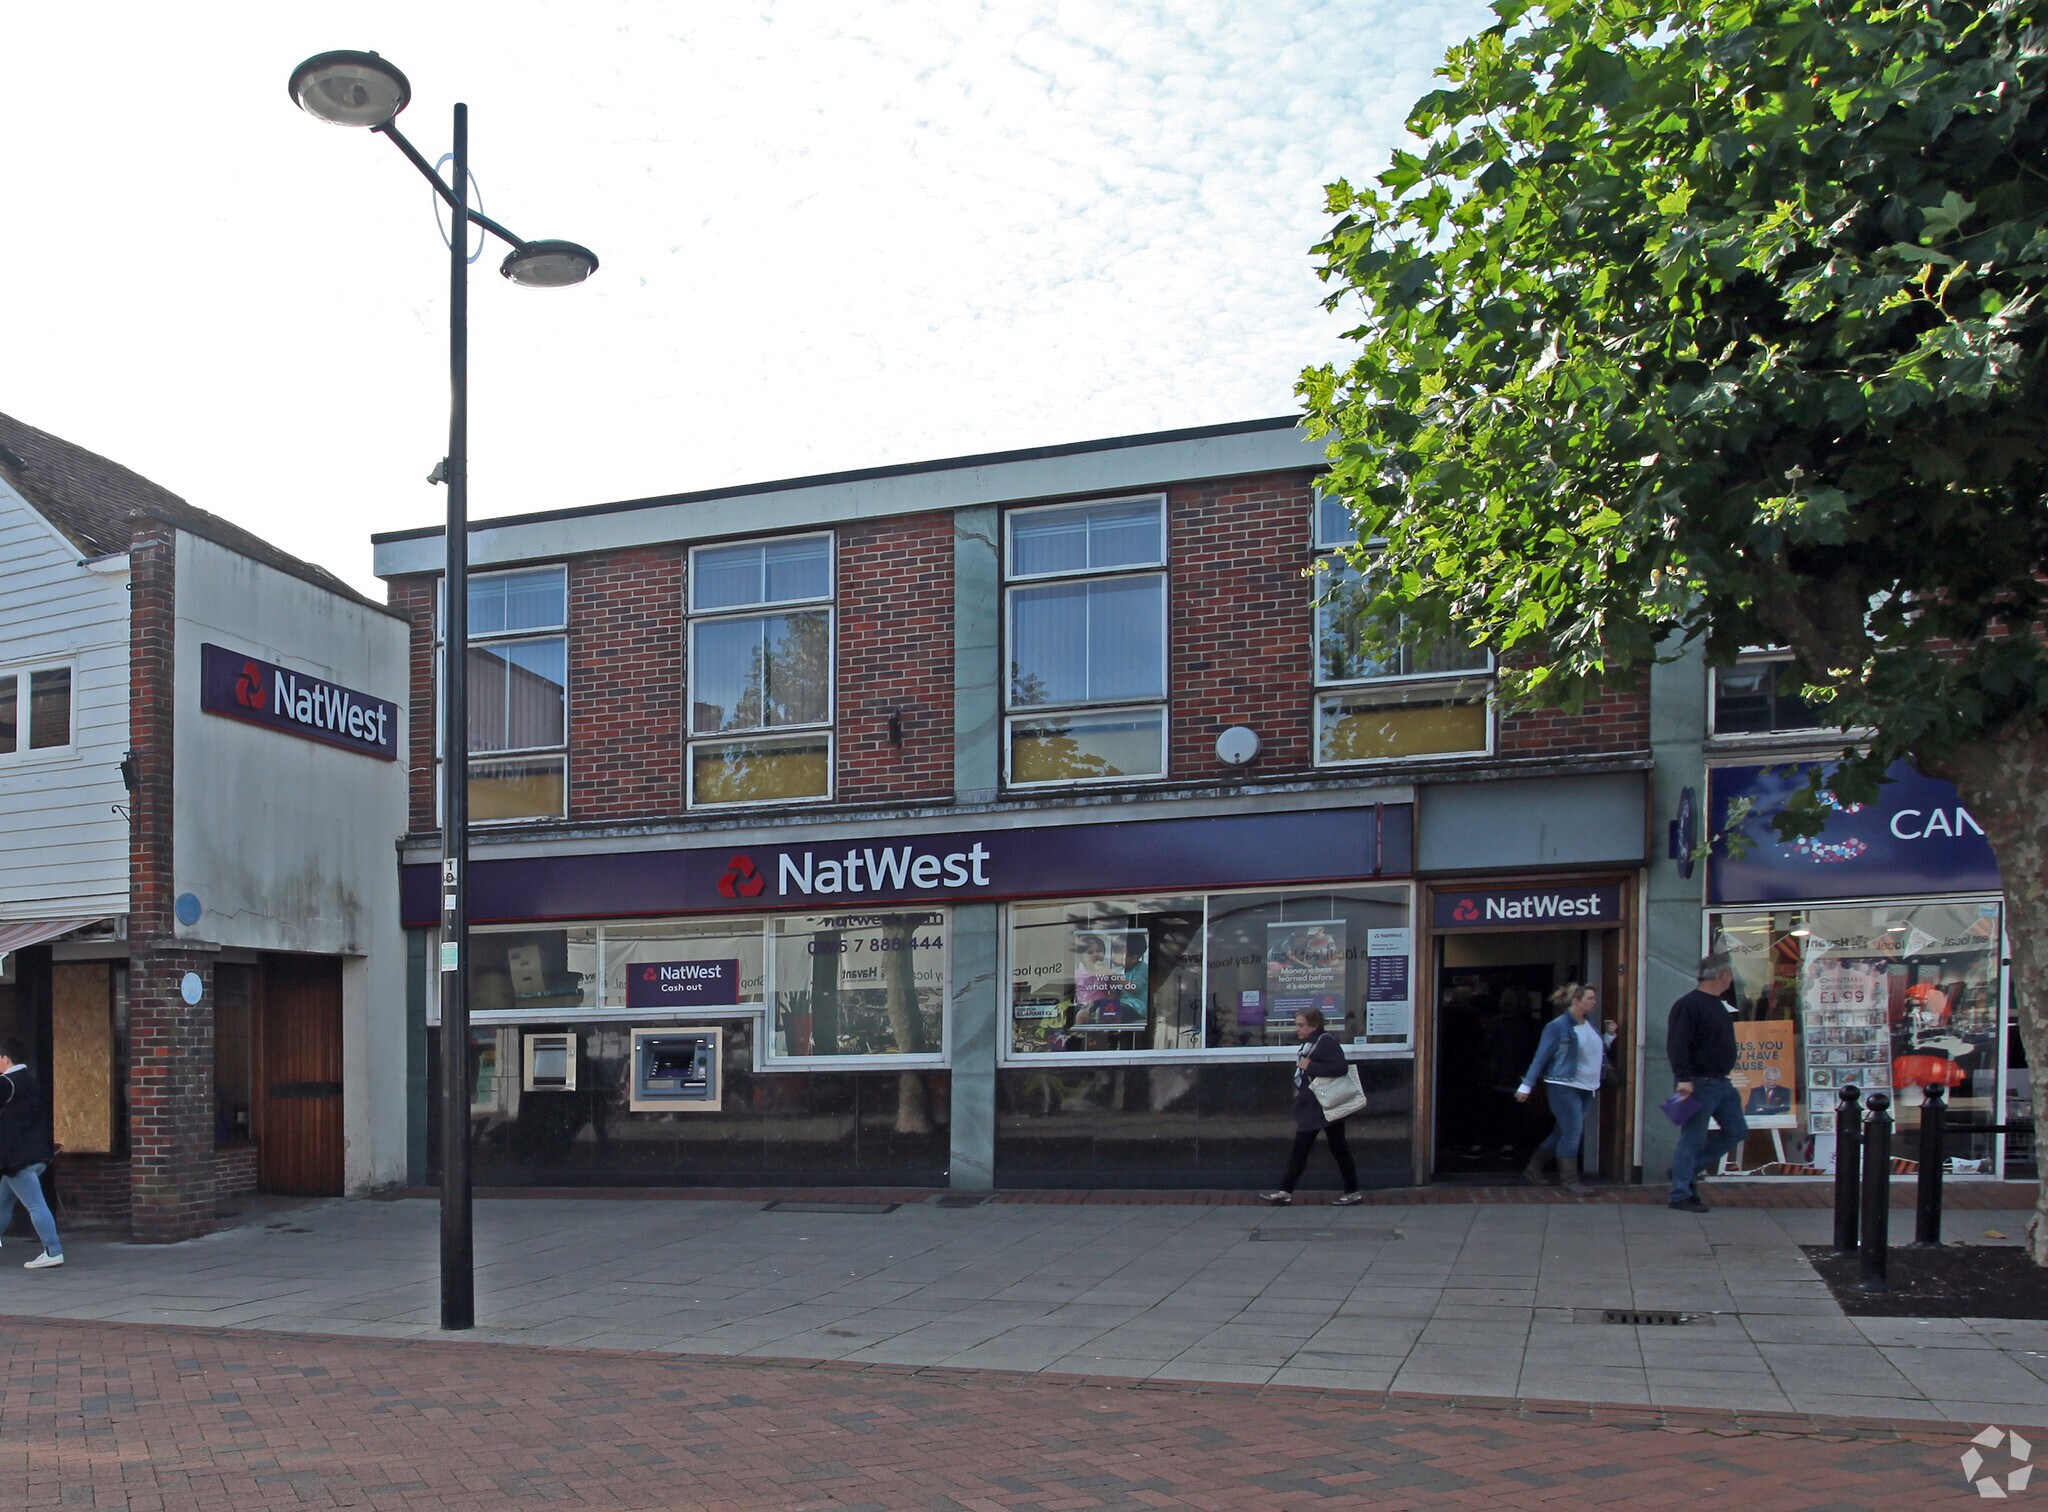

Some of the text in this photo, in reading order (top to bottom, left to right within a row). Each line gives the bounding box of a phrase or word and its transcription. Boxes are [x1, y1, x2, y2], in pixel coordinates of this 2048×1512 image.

[274, 670, 387, 745] NatWest
[778, 842, 990, 896] NatWest
[1485, 893, 1601, 919] NatWest
[823, 912, 944, 928] natwem
[807, 935, 944, 957] 05 7 888 444
[660, 965, 722, 981] NatWest
[1280, 967, 1306, 975] Money
[1315, 966, 1332, 974] best
[1095, 973, 1126, 982] We are
[1308, 973, 1334, 981] before
[661, 983, 702, 992] Cash out
[1085, 981, 1108, 991] what
[1124, 981, 1137, 990] do
[1286, 981, 1326, 990] it's earned
[1757, 1041, 1784, 1050] YOU
[1746, 1051, 1780, 1061] HAVE
[1733, 1061, 1768, 1071] AUSE.
